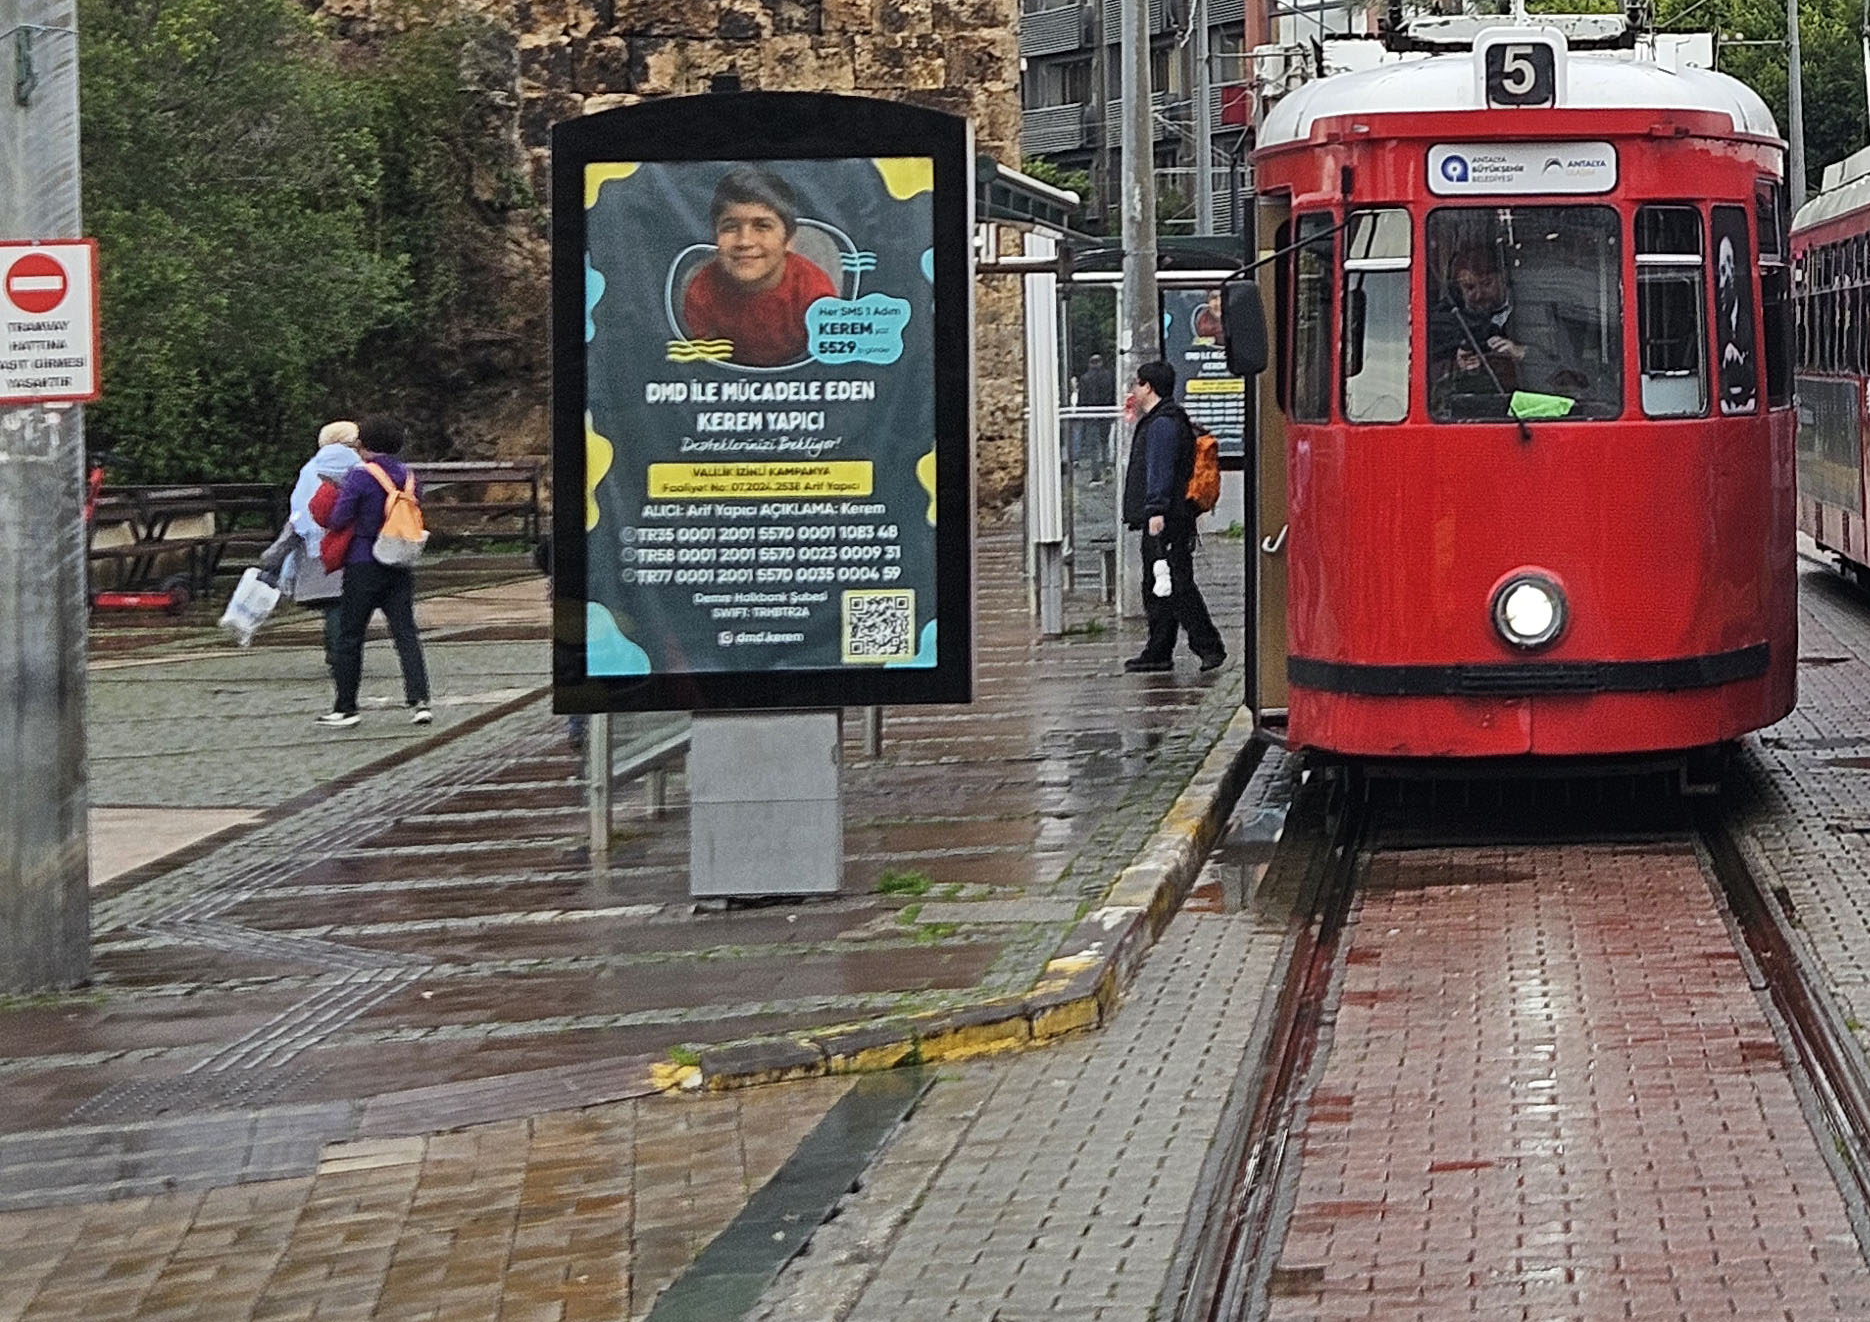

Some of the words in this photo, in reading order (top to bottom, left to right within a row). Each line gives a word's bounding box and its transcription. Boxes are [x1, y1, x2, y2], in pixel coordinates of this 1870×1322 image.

[1502, 45, 1536, 95] 5
[1567, 160, 1607, 168] ANTALYA
[841, 306, 863, 316] SMS
[818, 322, 873, 335] KEREM
[818, 340, 857, 354] 5529
[646, 382, 688, 403] DMD
[690, 379, 719, 402] İLE
[721, 378, 821, 402] MÜCADELE
[825, 381, 876, 400] EDEN
[696, 412, 763, 432] KEREM
[766, 411, 825, 430] YAPICI
[778, 435, 842, 457] Bekliyor!
[804, 480, 823, 490] Arif
[642, 505, 684, 518] ALICI:
[687, 504, 713, 517] Arif
[715, 504, 758, 520] Yapıcı
[759, 502, 839, 520] AÇIKLAMA:
[840, 502, 886, 515] Kerem
[636, 528, 675, 543] TR35
[676, 528, 716, 543] 0001
[718, 527, 755, 542] 2001
[757, 527, 795, 542] 5570
[797, 526, 836, 541] 0001
[838, 526, 875, 541] 1083
[876, 525, 899, 540] 48
[636, 548, 676, 563] TR58
[677, 548, 717, 563] 0001
[719, 548, 756, 563] 2001
[757, 548, 796, 563] 5570
[798, 547, 838, 562] 0023
[839, 546, 882, 561] 0009
[883, 545, 902, 560] 31
[636, 569, 674, 584] TR77
[675, 569, 715, 584] 0001
[717, 569, 754, 584] 2001
[755, 568, 794, 583] 5570
[795, 568, 836, 583] 0035
[837, 567, 880, 582] 0004
[882, 566, 902, 581] 59
[735, 592, 788, 603] Halkbank
[789, 590, 828, 604] Şubesi
[711, 607, 751, 618] SWIFT:
[735, 631, 805, 644] dmd.kerem
